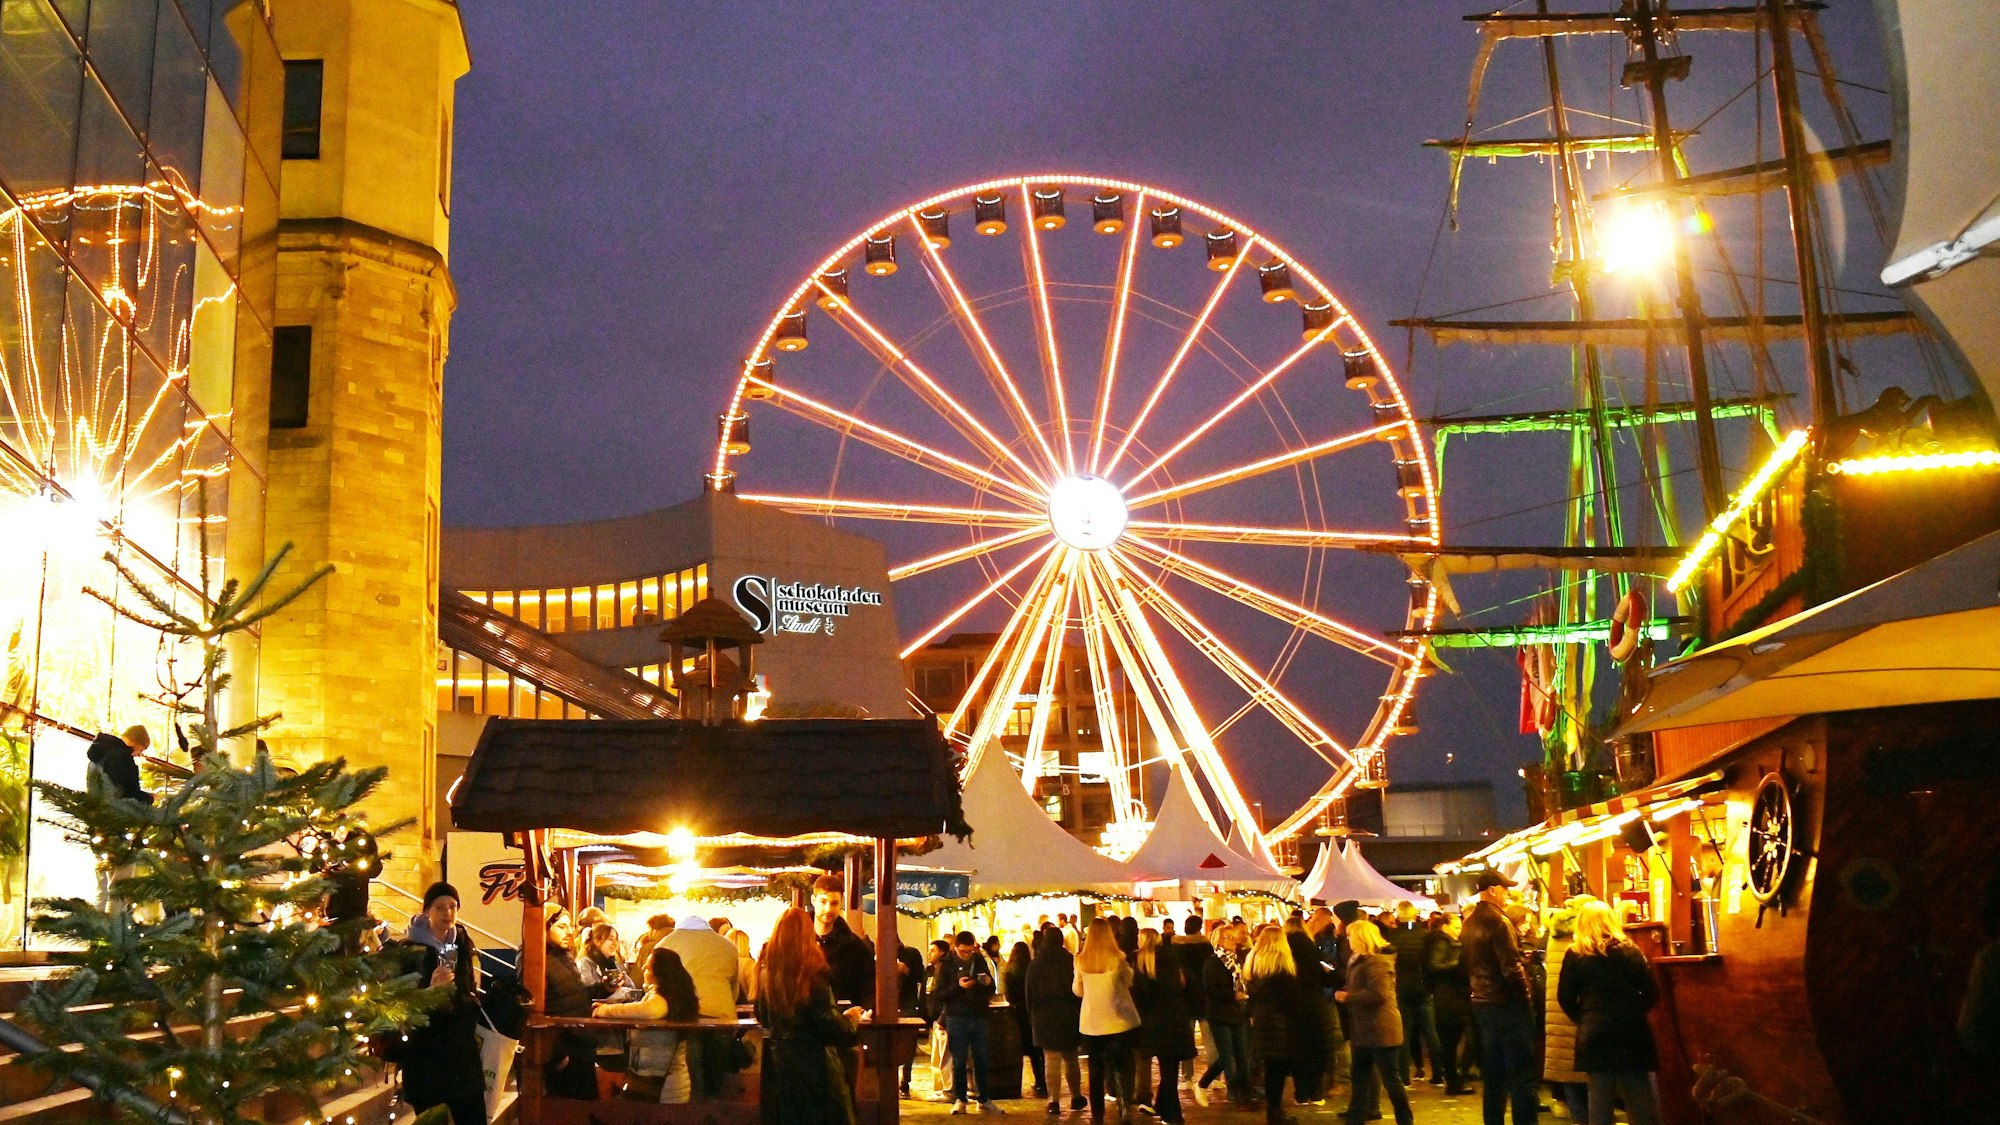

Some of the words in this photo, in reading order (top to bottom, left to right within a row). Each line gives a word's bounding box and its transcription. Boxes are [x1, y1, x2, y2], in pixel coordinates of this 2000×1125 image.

[777, 582, 881, 605] schokoladen
[777, 599, 848, 616] museum
[778, 614, 821, 633] Lindt
